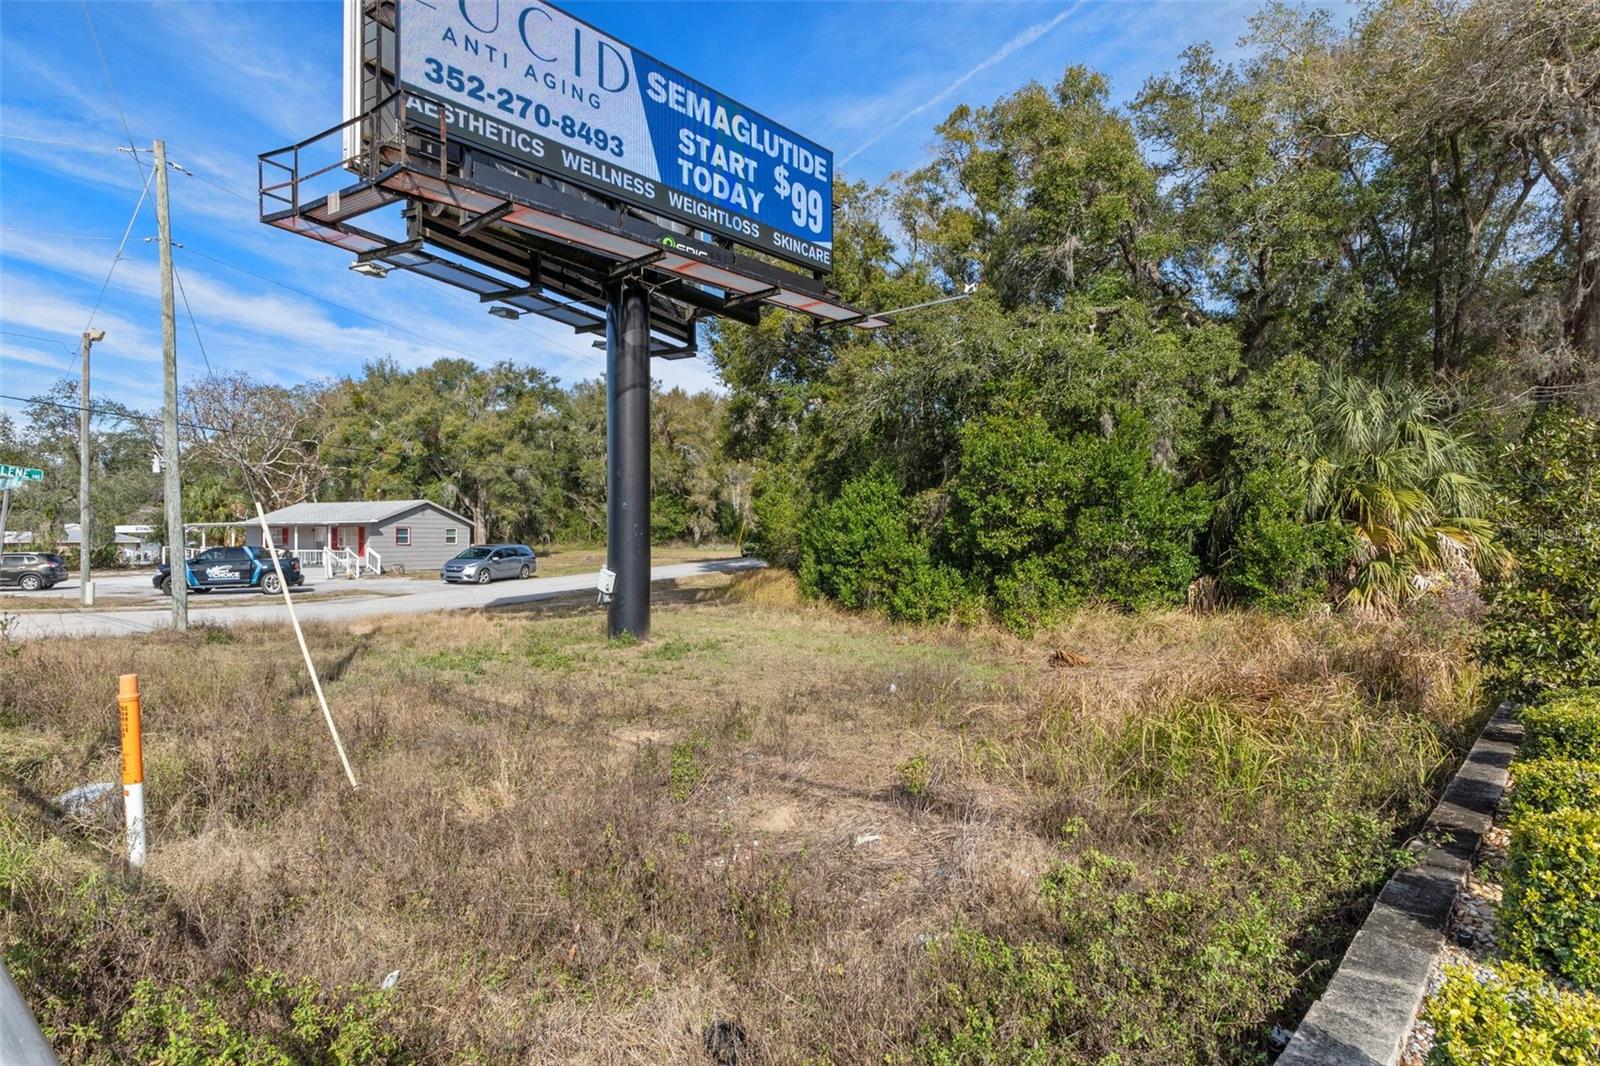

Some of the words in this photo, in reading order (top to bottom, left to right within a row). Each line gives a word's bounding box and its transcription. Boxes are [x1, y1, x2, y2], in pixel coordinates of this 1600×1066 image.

[415, 0, 630, 93] UCID
[442, 27, 508, 68] ANTI
[524, 64, 601, 109] AGING
[424, 57, 625, 158] 352-270-8493
[647, 71, 828, 183] SEMAGLUTIDE
[405, 91, 546, 158] AESTHETICS
[561, 149, 656, 199] WELLNESS
[668, 191, 760, 238] WEIGHTLOSS
[773, 232, 831, 265] SKINCARE
[678, 127, 758, 184] START
[678, 158, 765, 215] TODAY
[773, 164, 824, 234] $99
